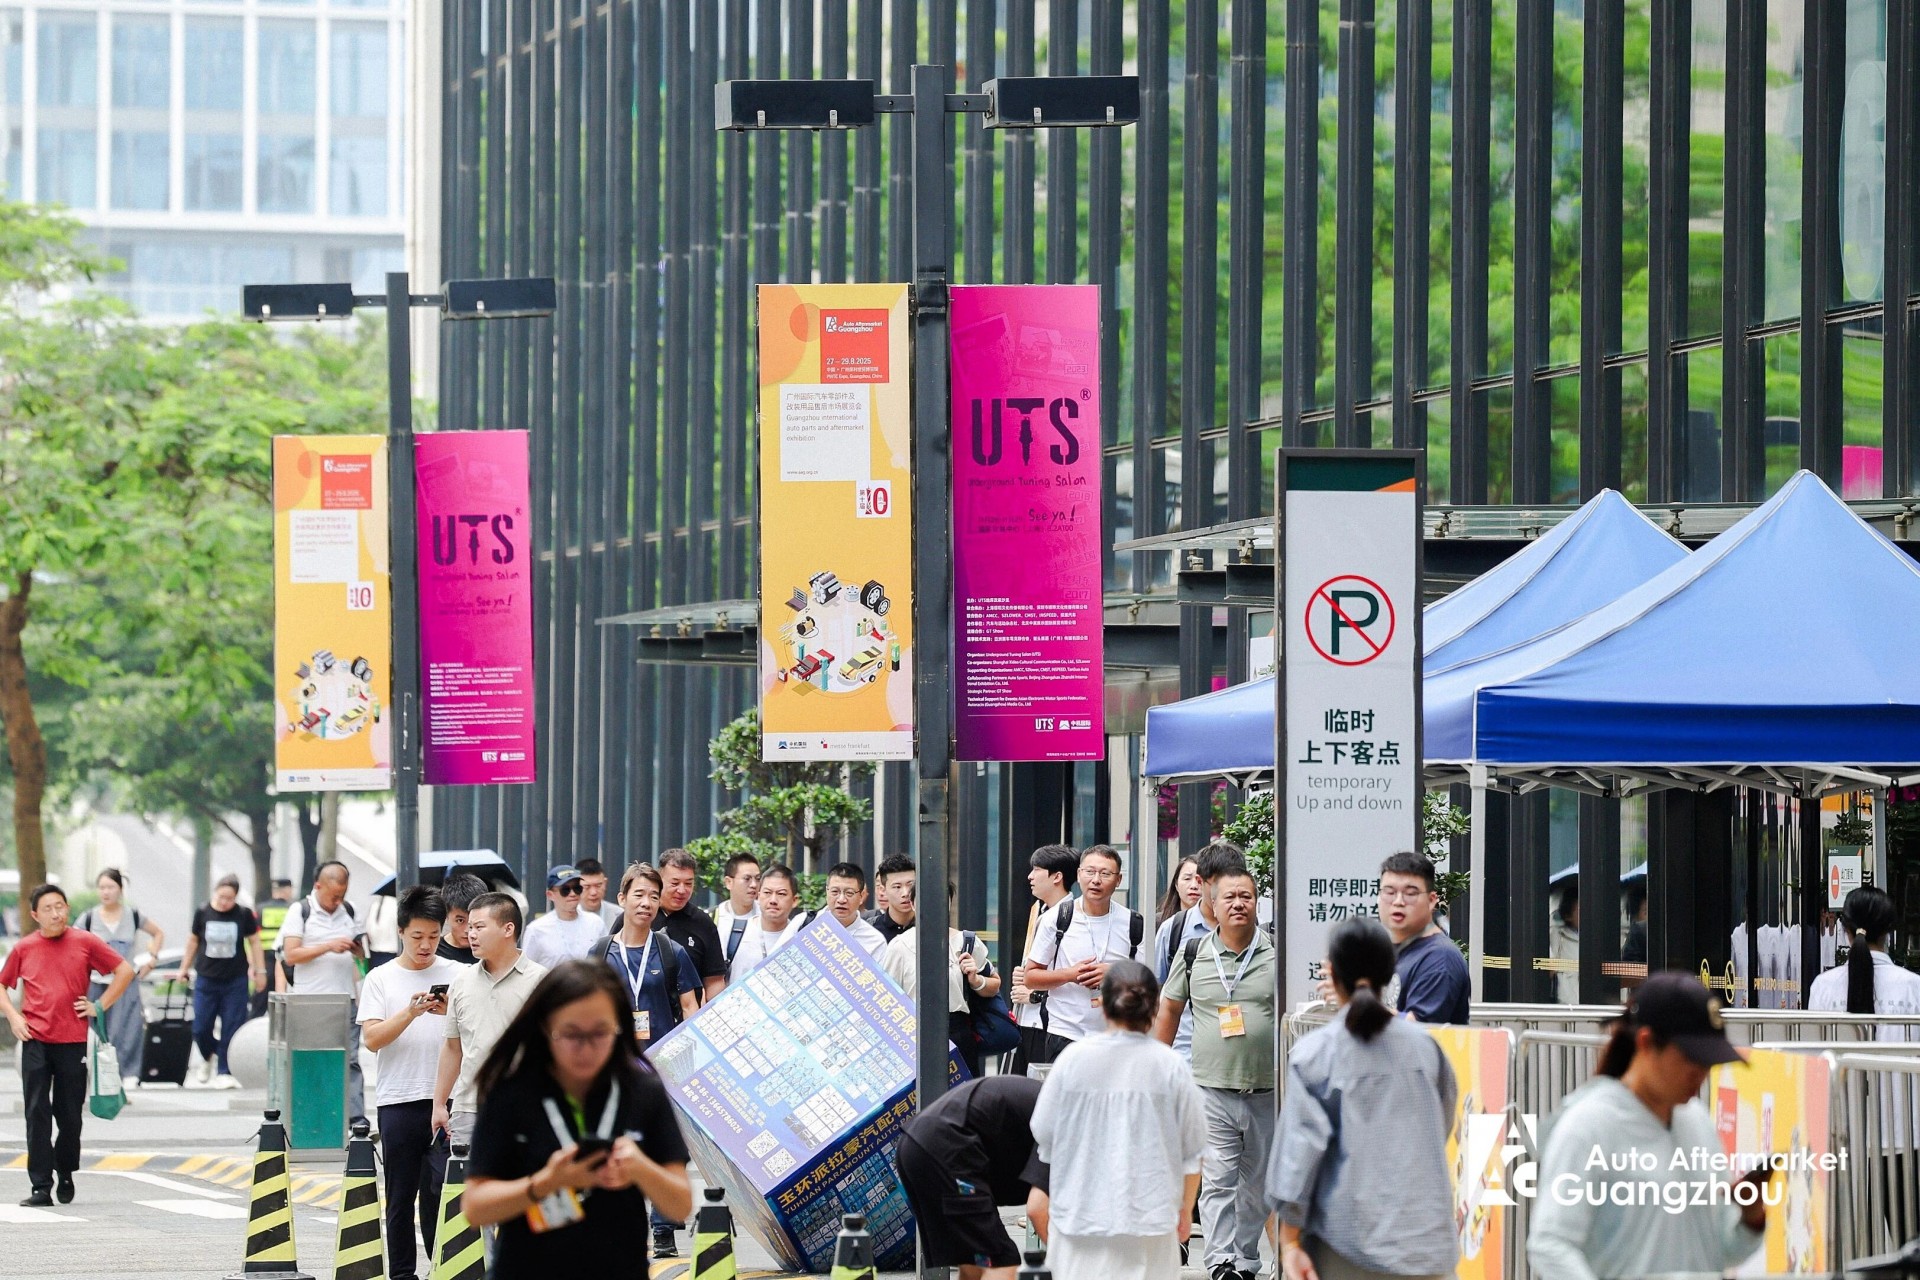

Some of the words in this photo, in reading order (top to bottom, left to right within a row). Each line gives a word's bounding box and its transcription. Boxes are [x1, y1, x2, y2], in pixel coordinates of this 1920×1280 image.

[1018, 477, 1050, 488] Tuning
[1056, 472, 1086, 486] Salon
[1028, 508, 1047, 520] See
[1035, 718, 1054, 730] UTS
[1324, 708, 1375, 734] 临时
[1298, 740, 1400, 766] 上下客点
[1308, 775, 1392, 793] temporary
[1297, 796, 1322, 812] Up
[1325, 795, 1353, 810] and
[1358, 794, 1402, 810] down
[801, 935, 828, 966] YUHUAN
[826, 962, 863, 1004] PARAMOUNT
[862, 1002, 881, 1021] AUTO
[878, 1017, 900, 1040] PARTS
[784, 1186, 821, 1215] YUHUAN
[822, 1142, 875, 1188] PARAMOUNT
[877, 1124, 899, 1146] AUTO
